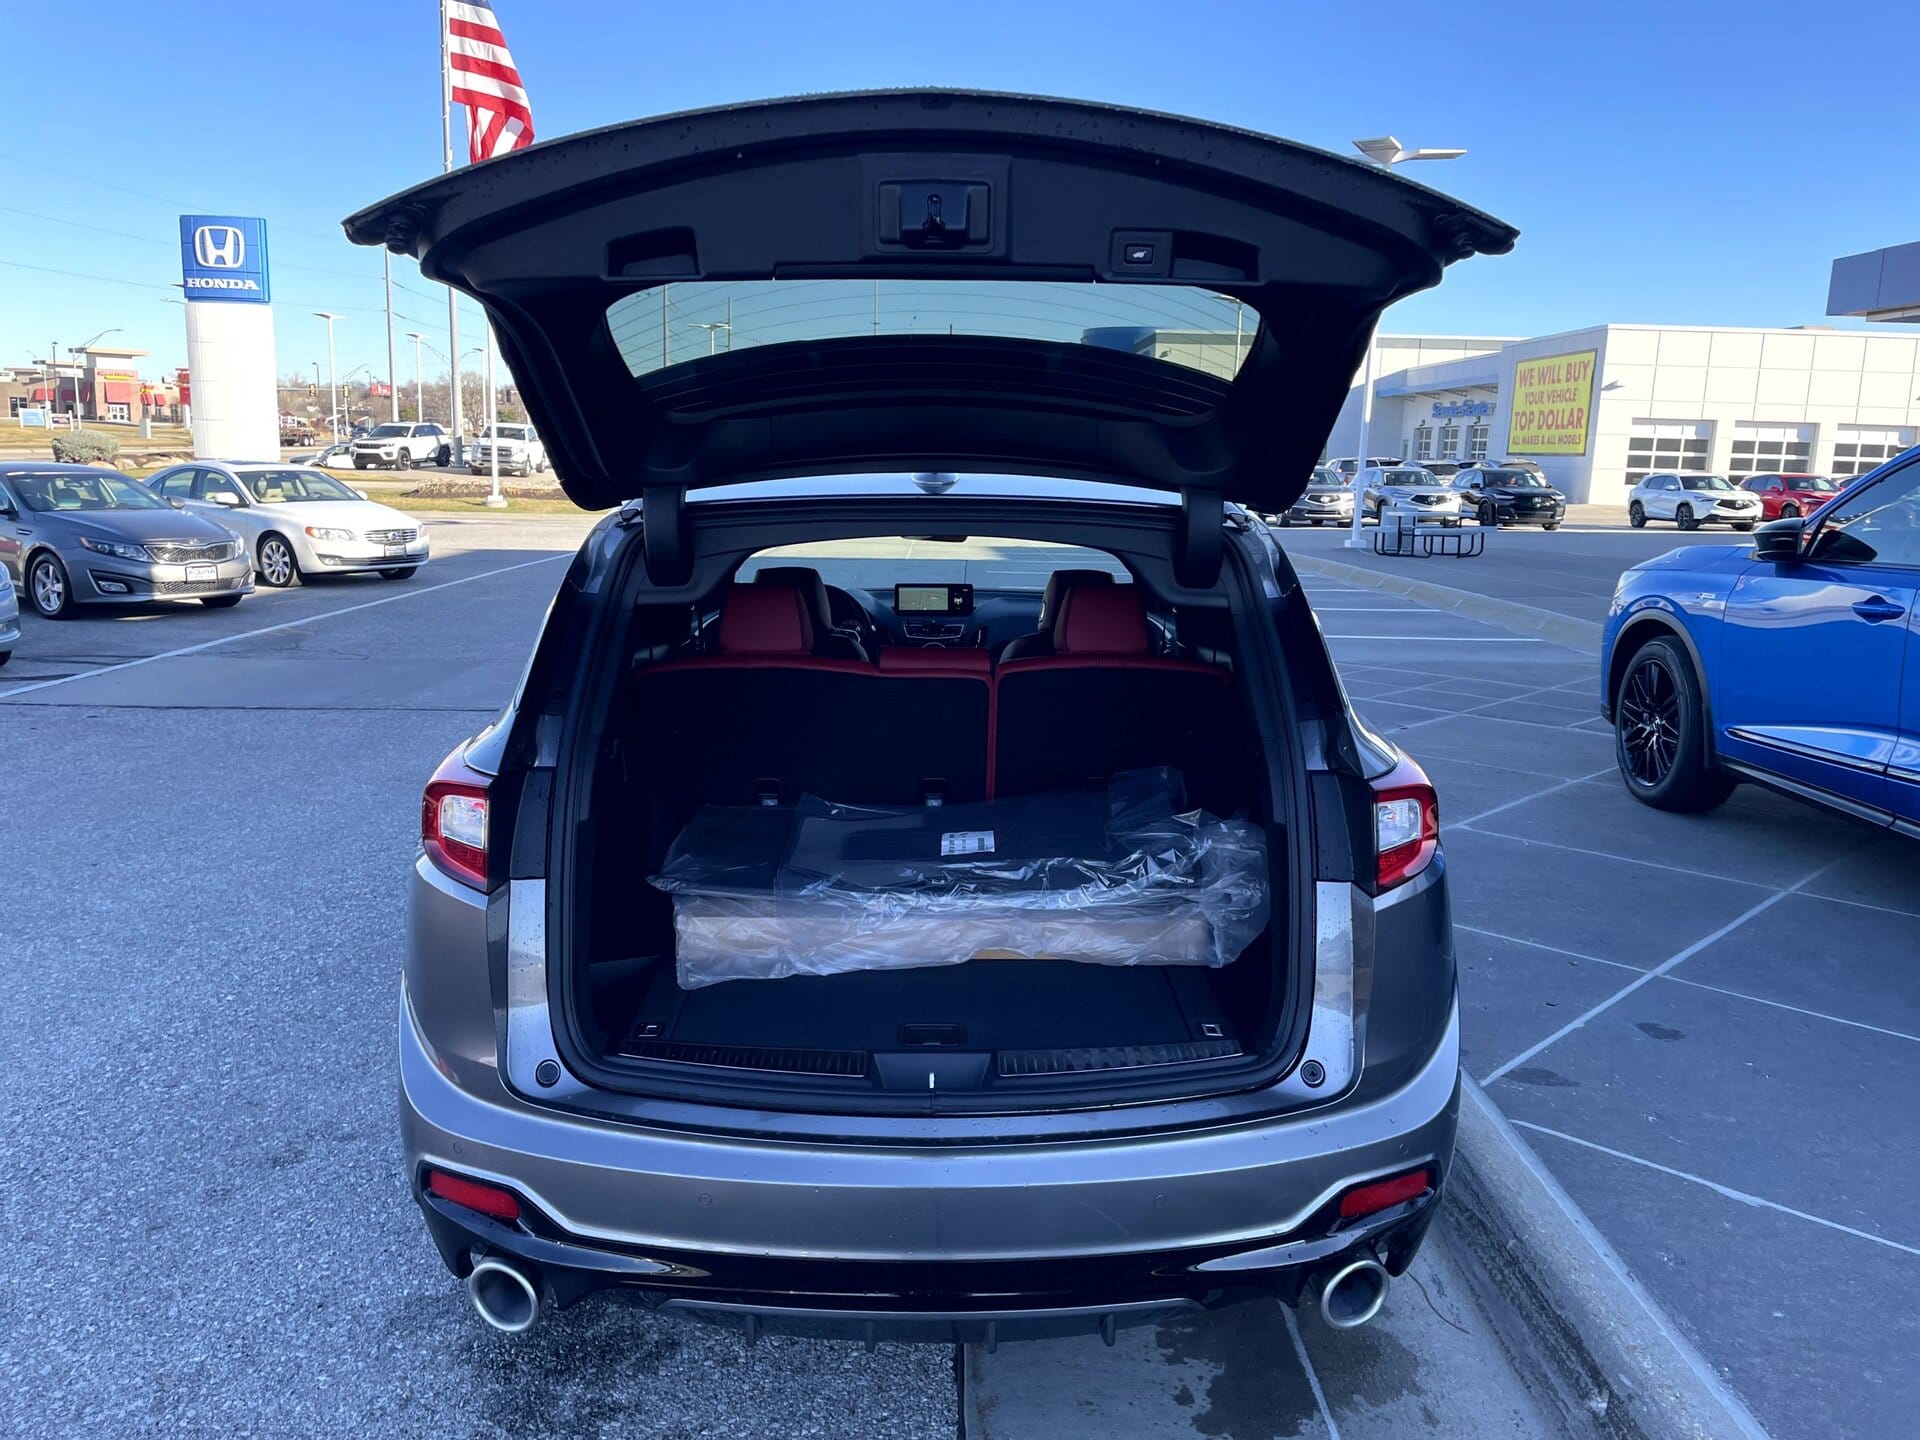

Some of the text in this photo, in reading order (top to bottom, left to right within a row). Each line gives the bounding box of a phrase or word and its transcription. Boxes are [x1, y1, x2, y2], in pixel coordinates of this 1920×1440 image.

[185, 277, 260, 290] HONDA
[1519, 360, 1590, 388] WE WILL BUY
[1524, 387, 1578, 406] YOUR VEHICLE
[1514, 407, 1584, 431] TOP DOLLAR
[1558, 434, 1582, 446] MODELS
